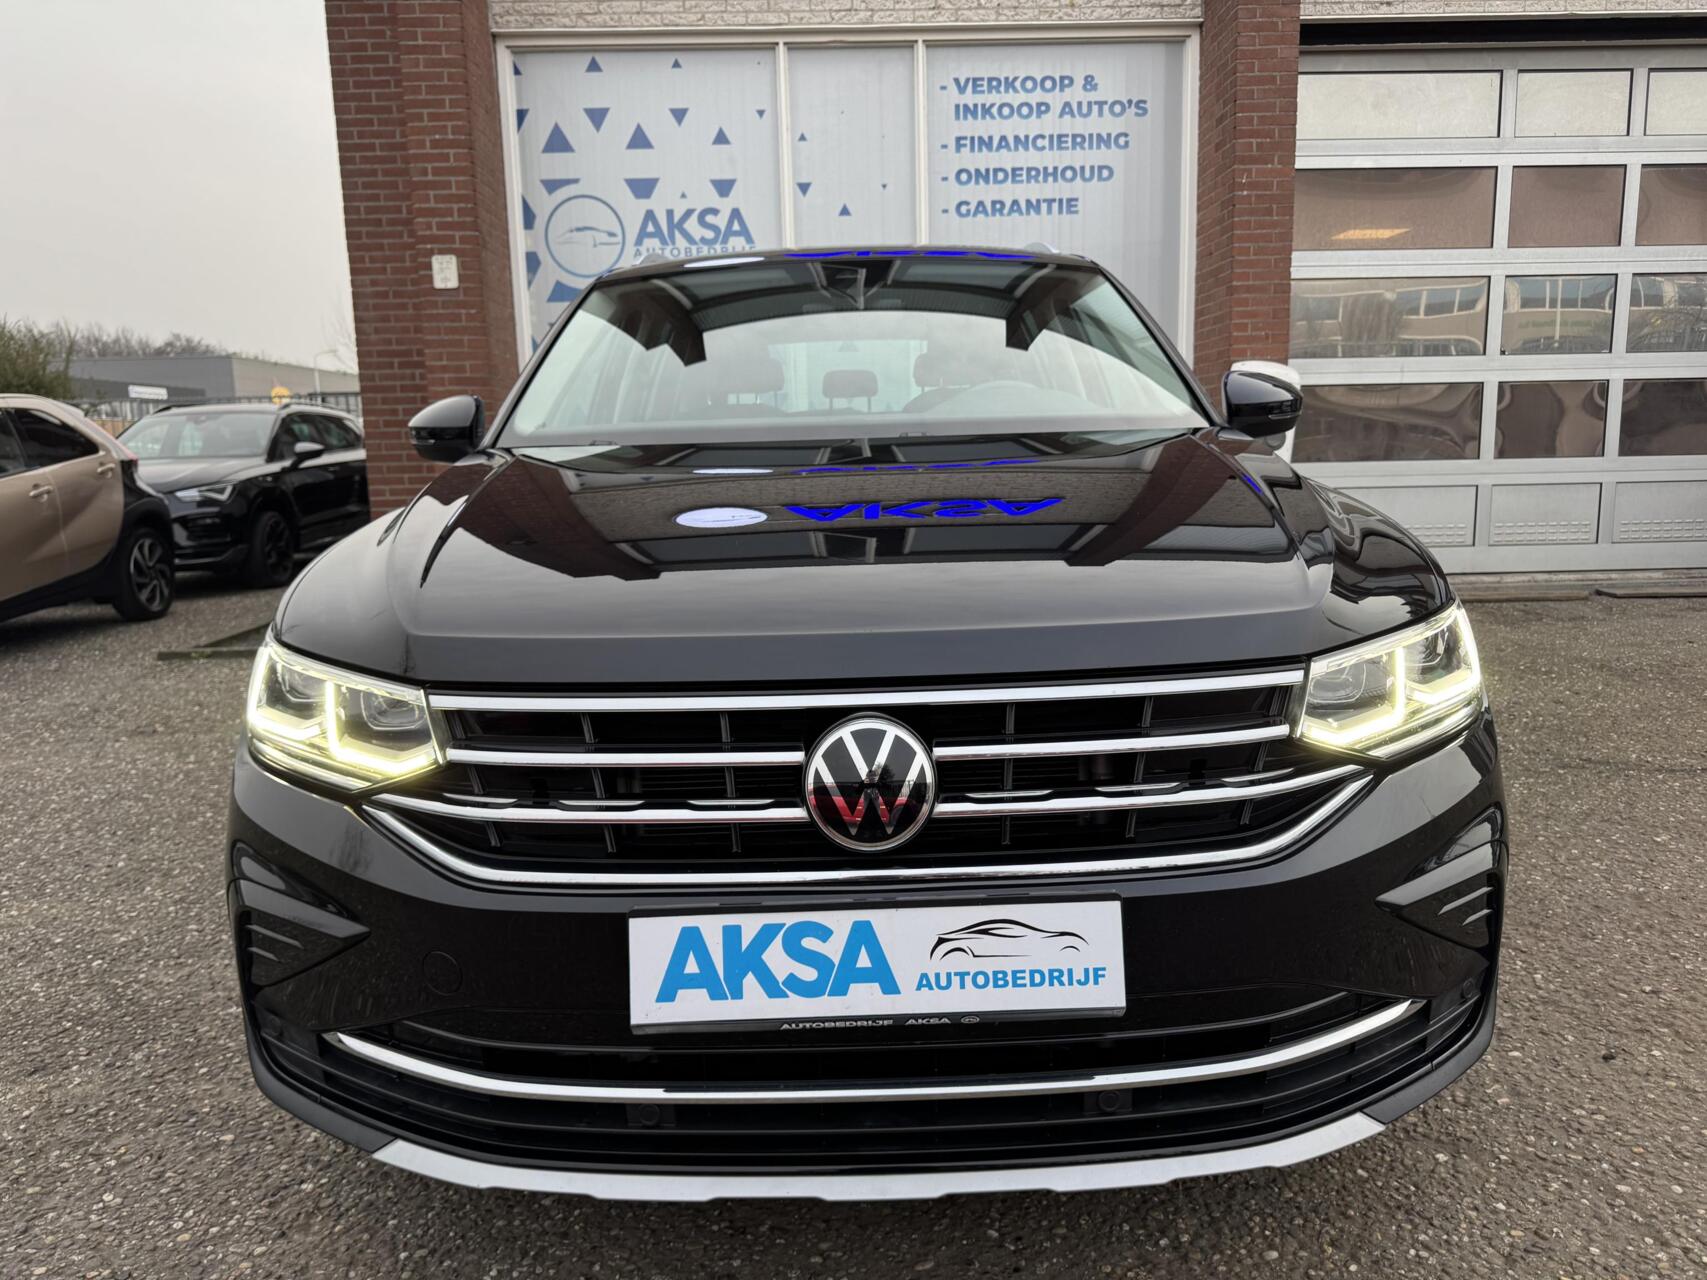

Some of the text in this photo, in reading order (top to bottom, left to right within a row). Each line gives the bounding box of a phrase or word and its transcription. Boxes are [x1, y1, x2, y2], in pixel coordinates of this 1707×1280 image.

[953, 75, 1075, 95] VERKOOP
[1081, 74, 1099, 93] &
[953, 98, 1149, 121] INKOOP AUTO'S
[954, 132, 1131, 154] FINANCIERING
[954, 165, 1115, 186] ONDERHOUD
[954, 197, 1080, 218] GARANTIE
[633, 207, 756, 247] AKSA
[655, 919, 901, 1003] AKSA
[915, 966, 1107, 991] AUTOBEDRIJF
[780, 1016, 952, 1031] AUTOBEDRIJF AKSA
